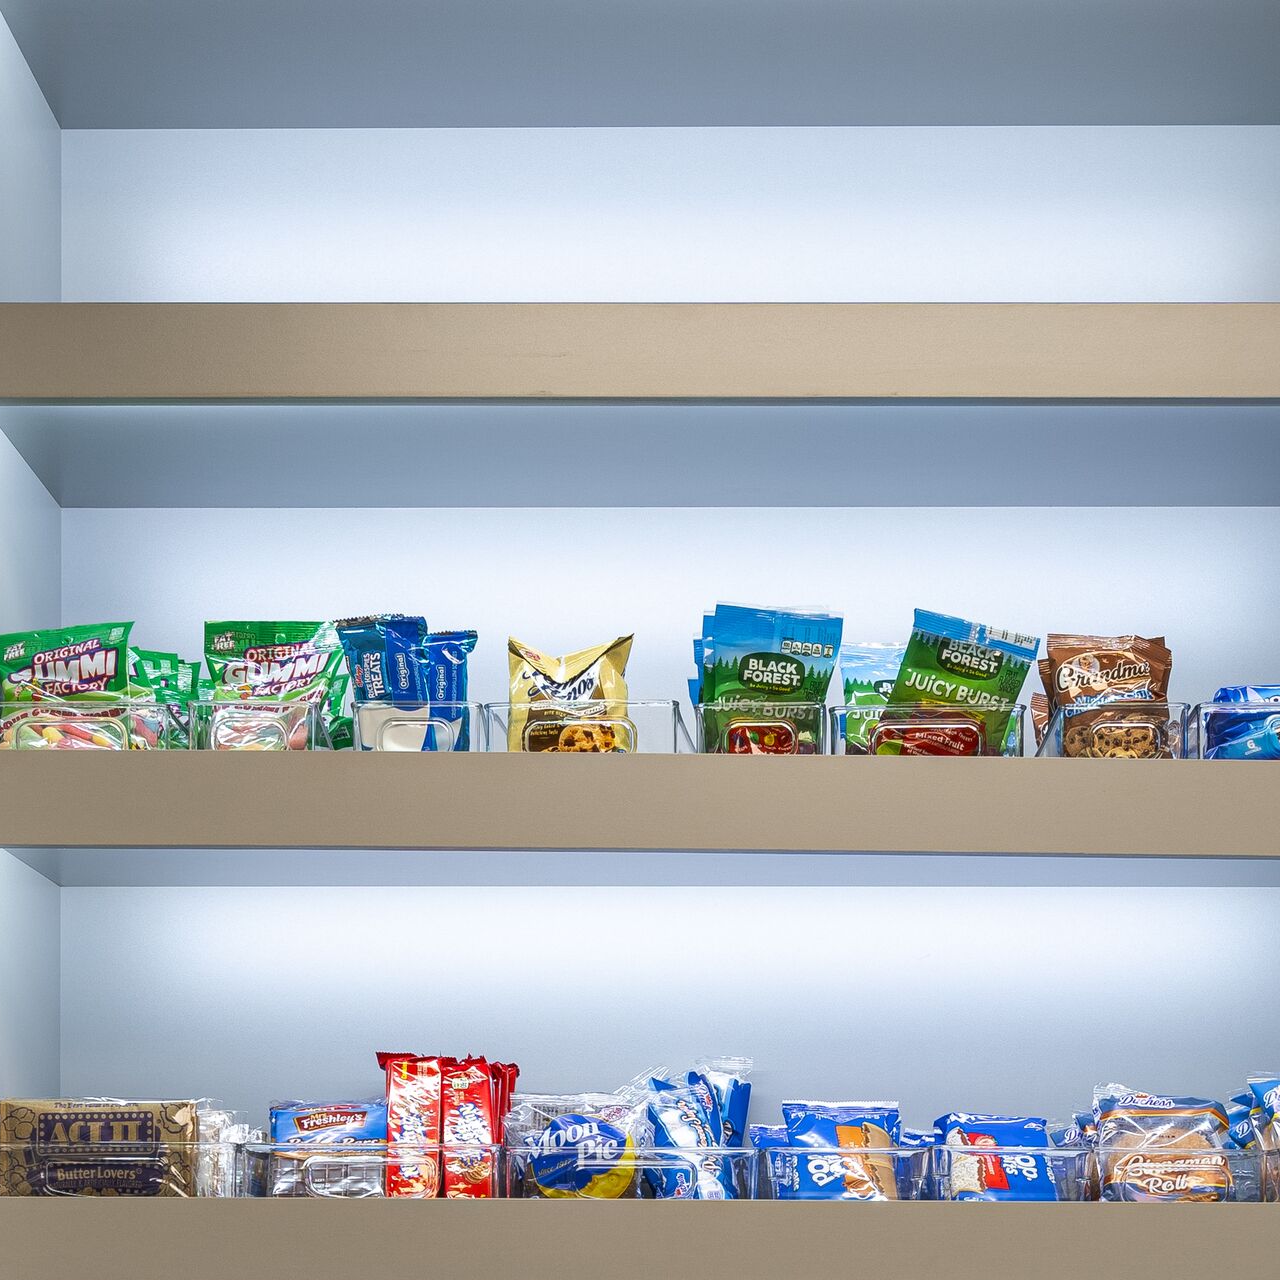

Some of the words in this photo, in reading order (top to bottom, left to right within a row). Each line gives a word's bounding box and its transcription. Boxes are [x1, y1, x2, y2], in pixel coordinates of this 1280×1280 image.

[6, 642, 24, 655] FAT
[214, 633, 231, 644] FAT
[4, 648, 25, 662] FREE
[33, 638, 101, 665] ORIGINAL
[948, 639, 995, 660] BLACK
[224, 653, 332, 684] GUMMI
[363, 653, 371, 683] KRISPIES
[398, 653, 406, 689] Original
[747, 658, 797, 675] BLACK
[942, 648, 997, 674] FOREST
[373, 653, 385, 697] TREATS
[437, 666, 445, 699] Original
[743, 670, 798, 686] FOREST
[45, 678, 107, 696] FACTORY
[253, 677, 314, 697] FACTORY
[904, 669, 957, 698] JUICY
[955, 686, 1010, 712] BURST
[763, 704, 817, 721] BURST
[915, 731, 944, 746] Mixed
[944, 737, 965, 753] Fruit
[1119, 1094, 1176, 1111] Duchess
[300, 1112, 363, 1130] Freshley's
[50, 1121, 103, 1144] ACT
[110, 1120, 142, 1142] II
[524, 1122, 600, 1160] Moon
[574, 1138, 618, 1170] Pie
[1125, 1153, 1227, 1175] Cinnamon
[57, 1168, 96, 1180] Butter
[97, 1167, 136, 1180] Lovers
[1145, 1173, 1189, 1193] Roll
